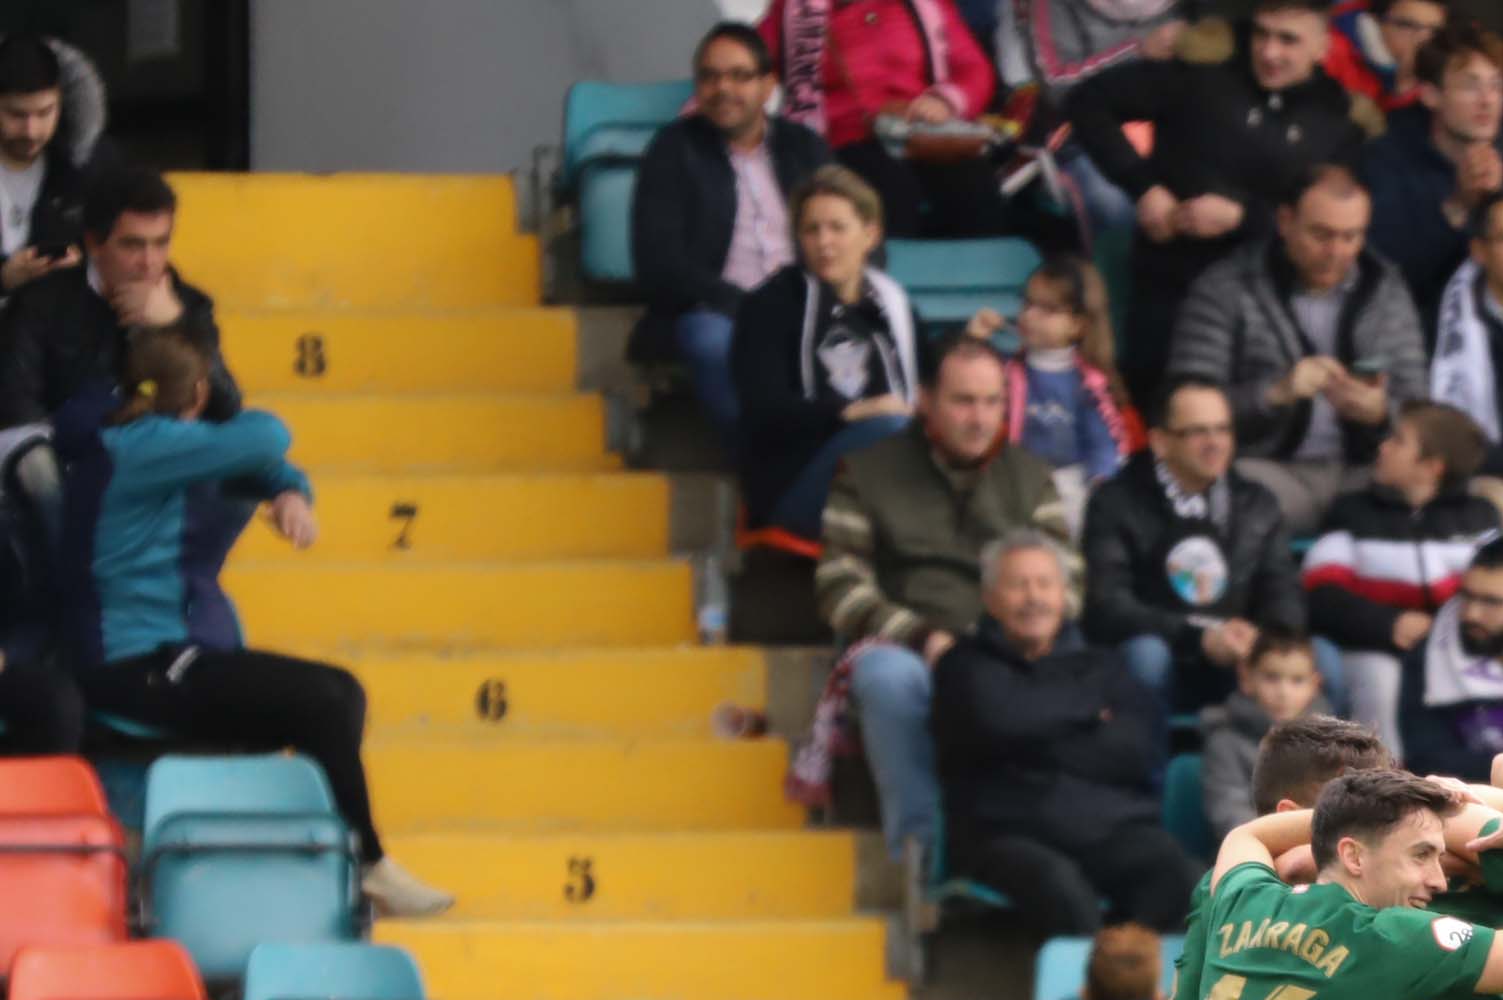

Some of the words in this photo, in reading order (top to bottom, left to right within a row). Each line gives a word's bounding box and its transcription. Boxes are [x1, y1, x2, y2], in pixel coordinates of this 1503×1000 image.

[294, 335, 328, 378] 8
[389, 502, 418, 551] 7
[476, 681, 509, 722] 6
[563, 856, 596, 903] 5
